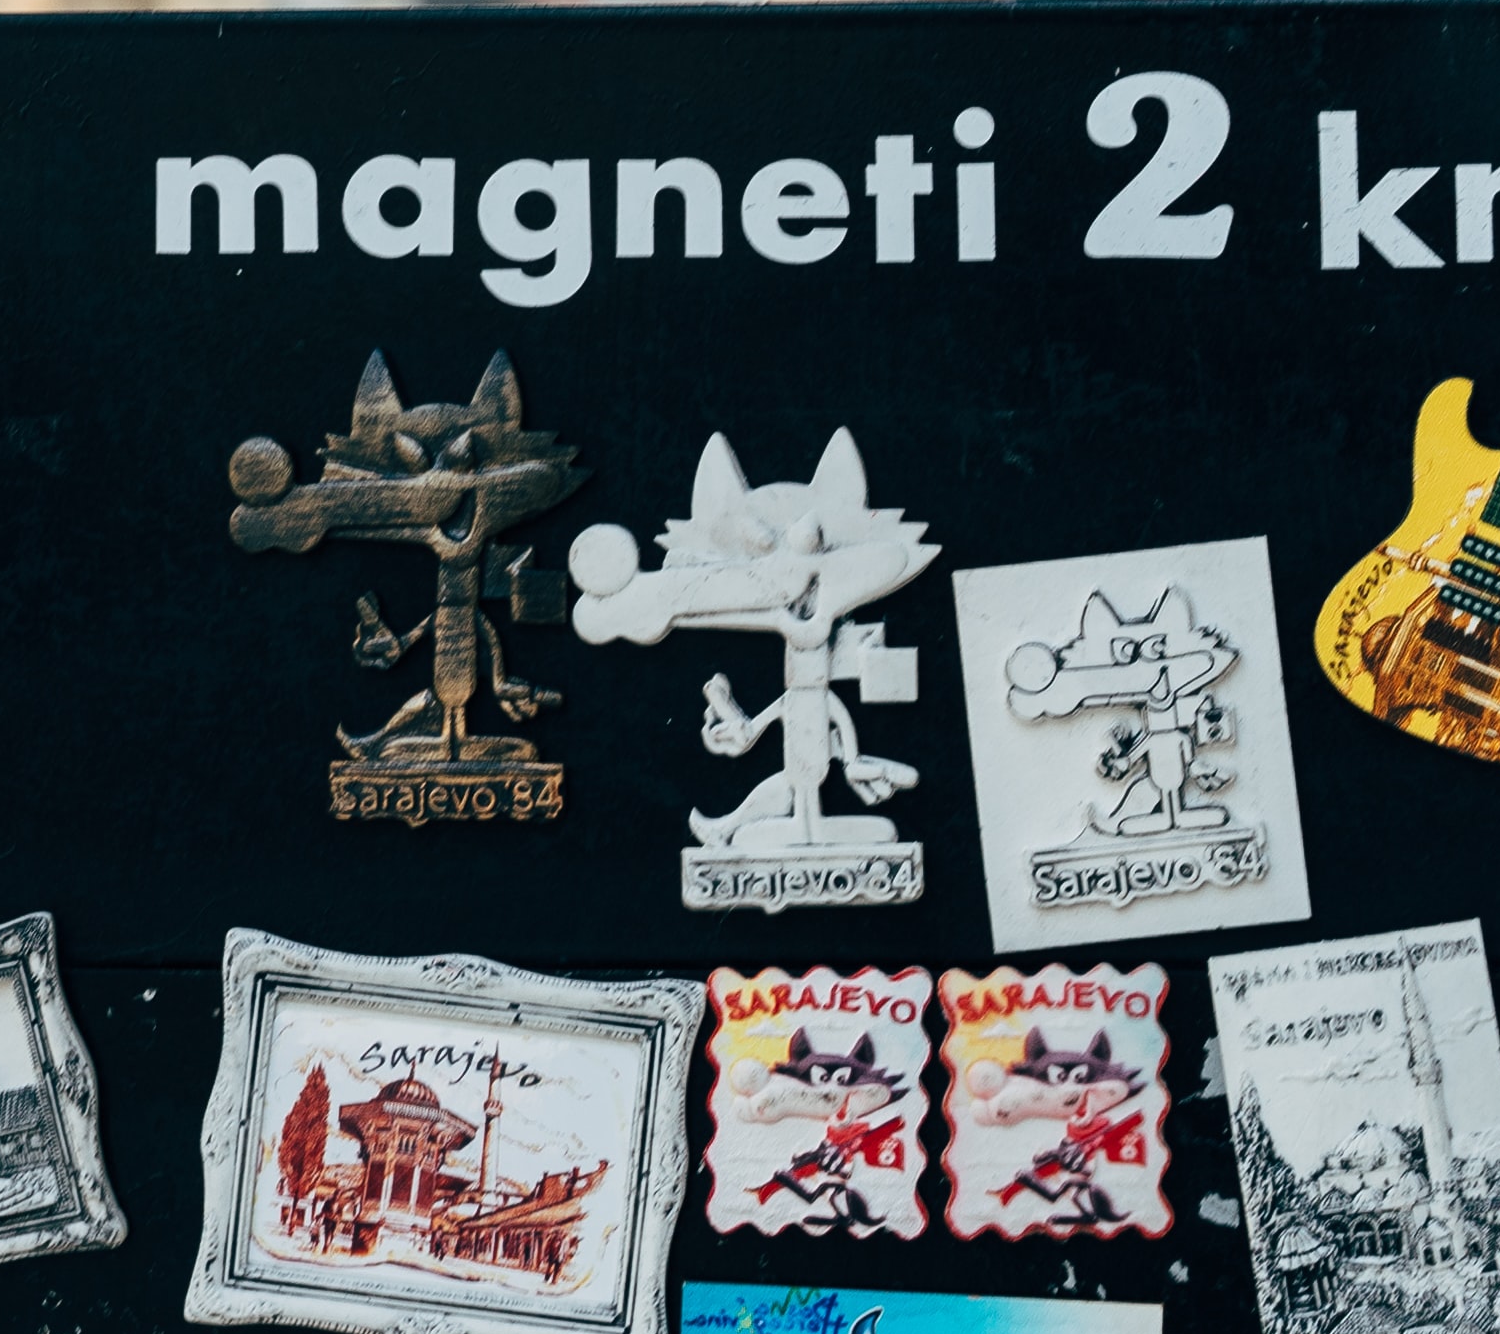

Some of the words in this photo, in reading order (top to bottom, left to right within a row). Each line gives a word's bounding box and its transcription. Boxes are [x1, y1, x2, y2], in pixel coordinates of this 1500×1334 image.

[155, 105, 998, 308] magneti
[1085, 69, 1235, 259] 2
[331, 780, 497, 821] Sarajevo
[694, 864, 855, 906] Sarajevo
[1032, 855, 1201, 902] Sarajevo
[724, 980, 918, 1024] SARAJEVO
[955, 979, 1152, 1023] SARAJEVO
[1241, 1007, 1388, 1051] Sarajevo
[359, 1036, 543, 1086] Sarajevo
